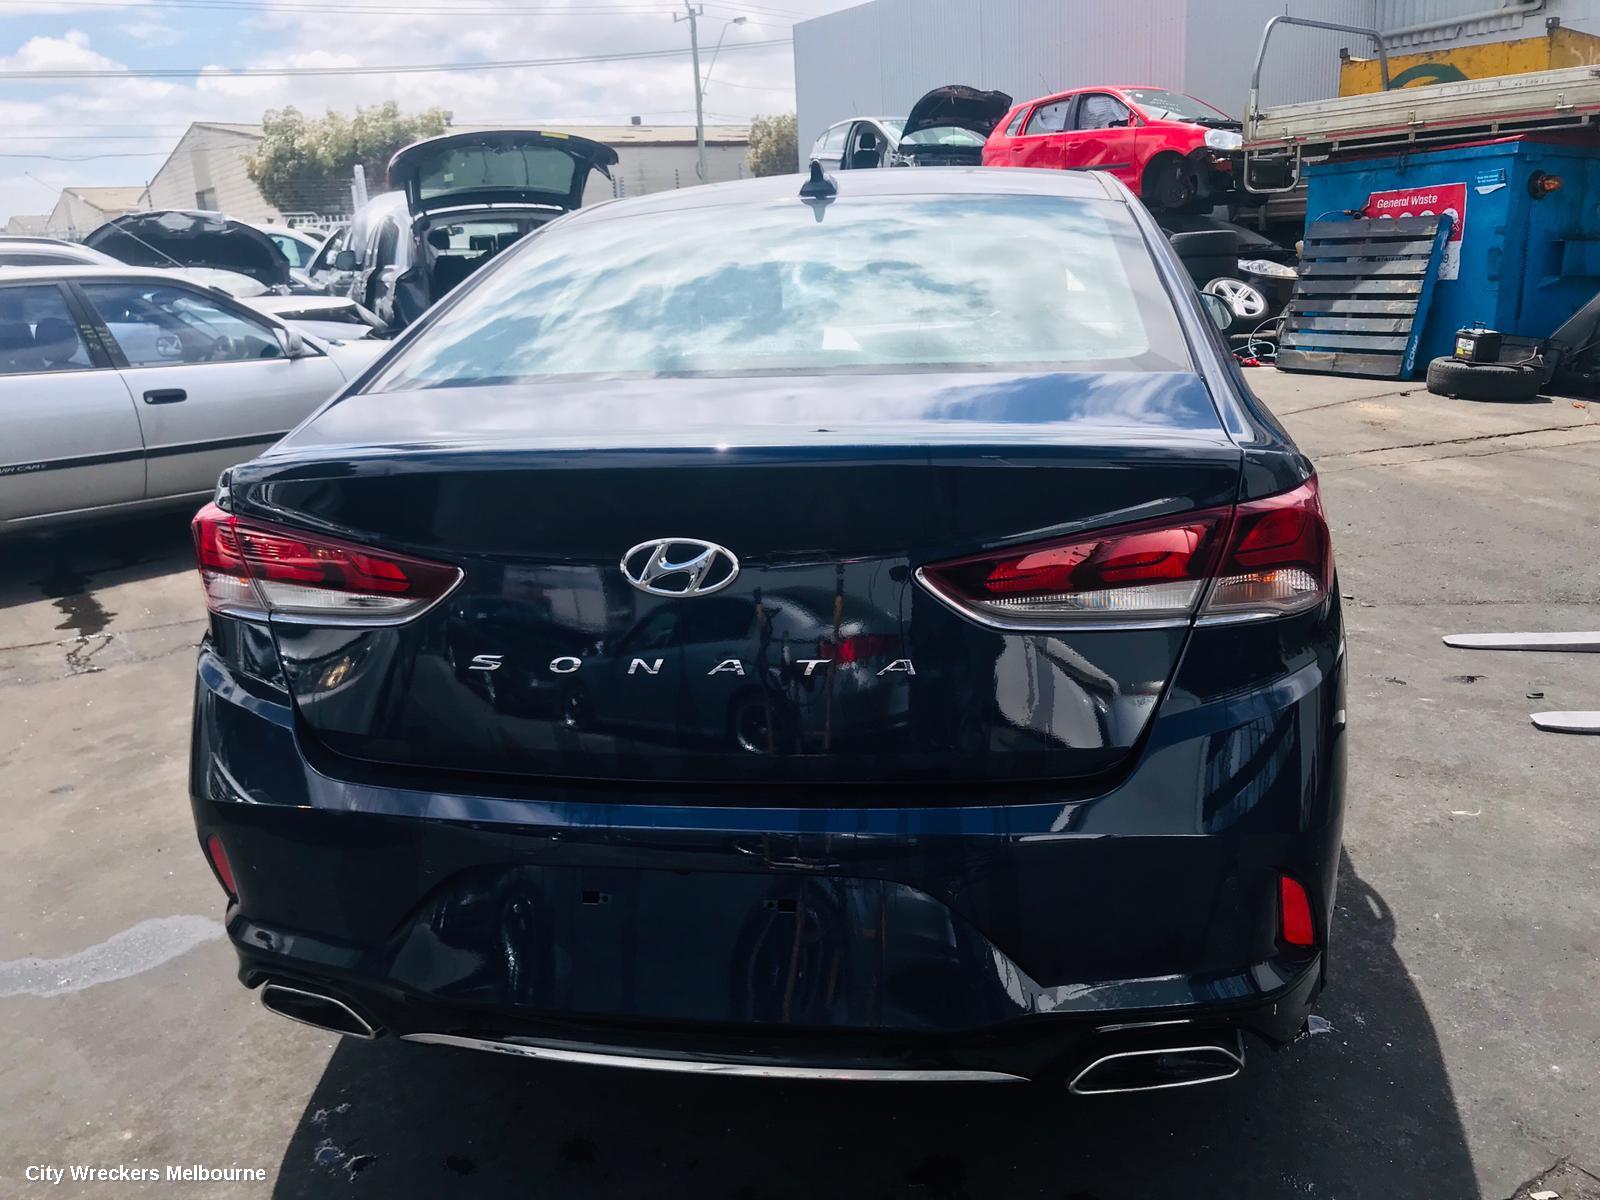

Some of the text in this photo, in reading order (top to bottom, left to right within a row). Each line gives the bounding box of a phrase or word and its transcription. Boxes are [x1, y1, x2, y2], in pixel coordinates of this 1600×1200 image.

[1377, 194, 1438, 208] General Waste
[468, 654, 917, 677] SONATA
